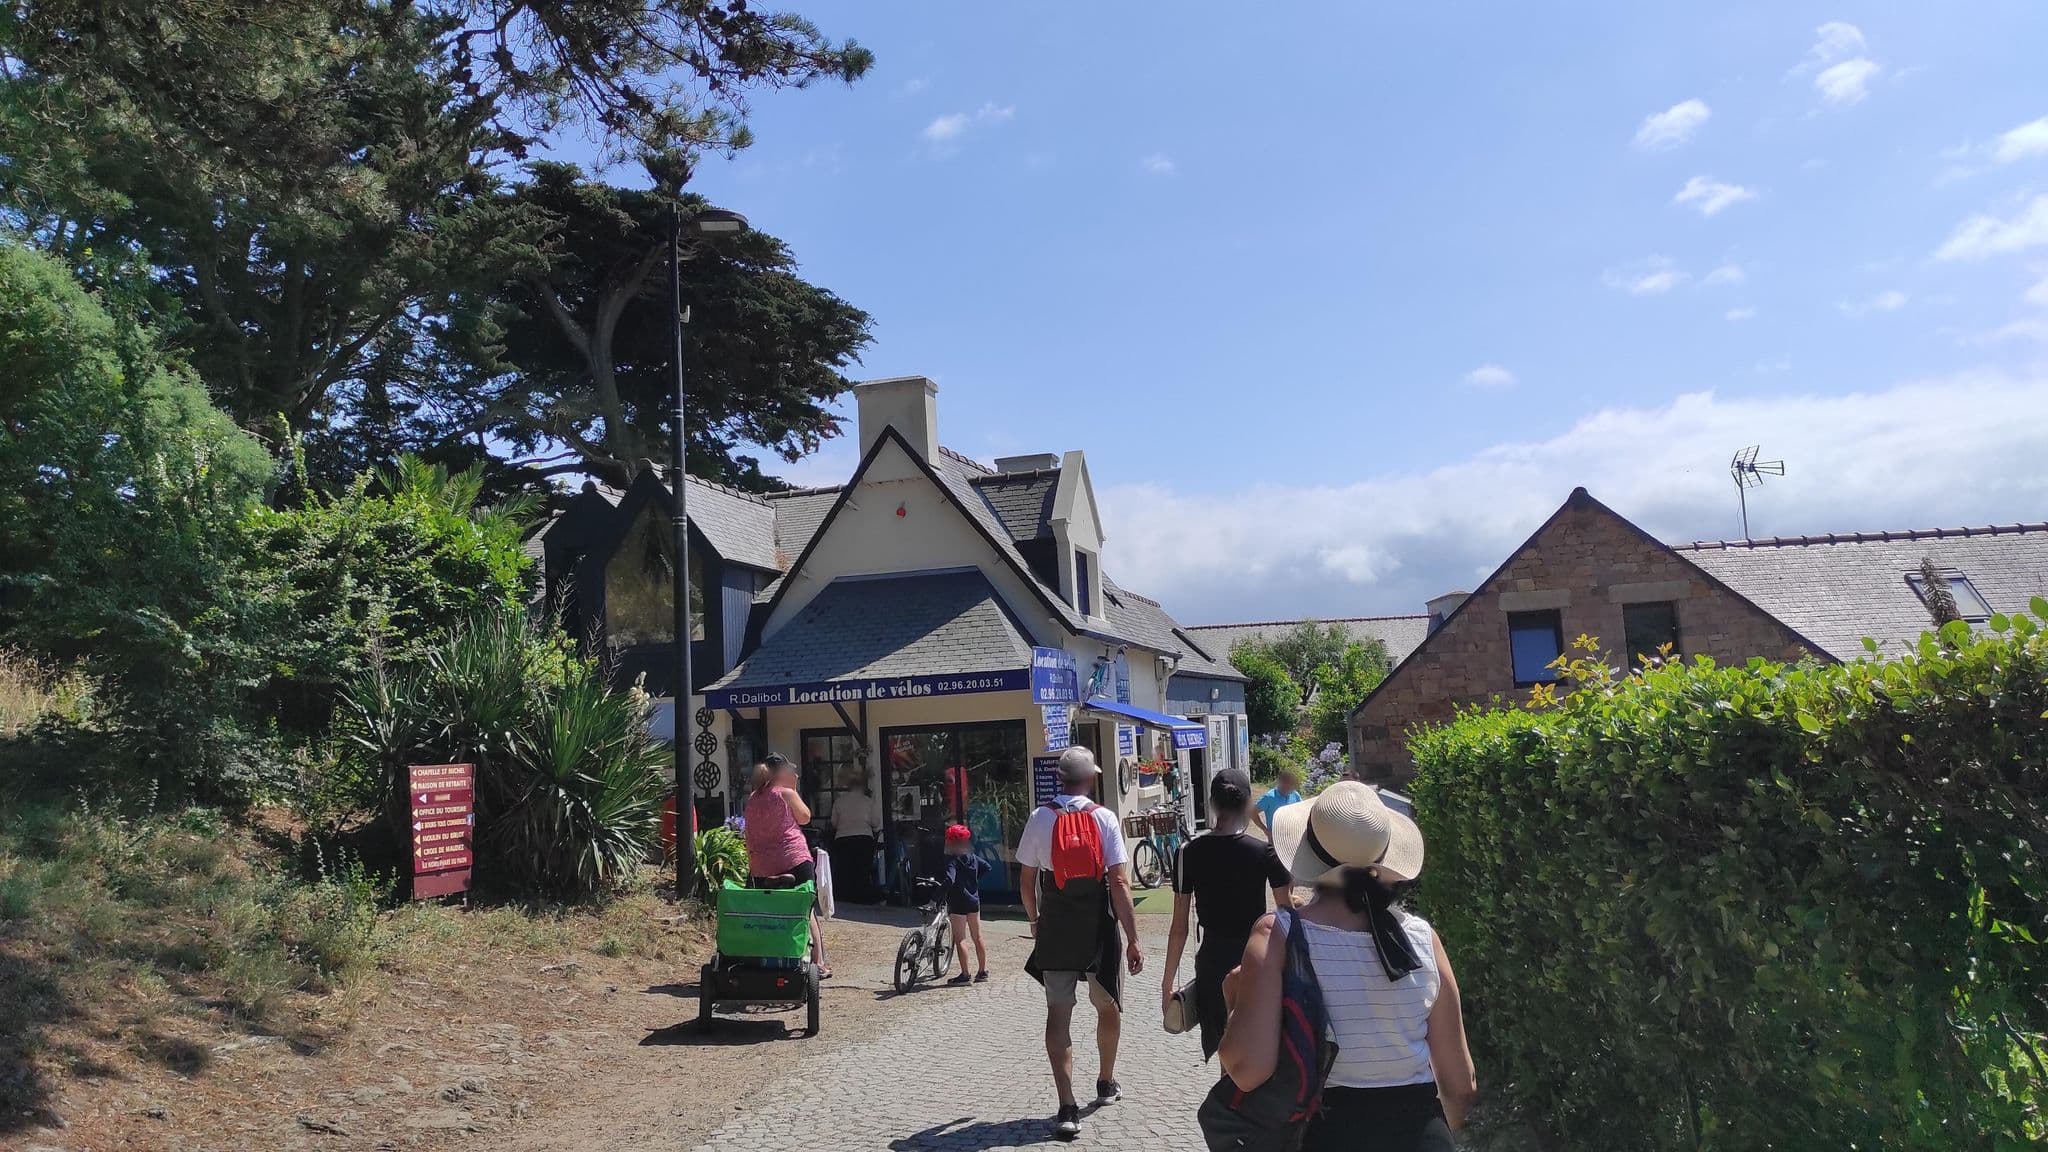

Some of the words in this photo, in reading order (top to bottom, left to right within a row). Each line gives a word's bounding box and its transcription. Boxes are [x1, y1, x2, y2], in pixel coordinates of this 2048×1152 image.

[1033, 649, 1058, 669] Location
[730, 692, 782, 705] R.Dalibot
[788, 685, 862, 704] Location
[866, 682, 886, 699] de
[889, 679, 932, 698] vélos
[937, 678, 1004, 692] 02.96.20.03.51
[417, 768, 441, 777] CHAPELLE
[417, 782, 438, 790] MAISON
[418, 808, 436, 816] OFFICE
[436, 807, 444, 815] DU
[444, 805, 467, 814] TOURISME
[422, 833, 442, 842] MOULIN
[423, 847, 438, 856] CROIX
[438, 846, 445, 854] DE
